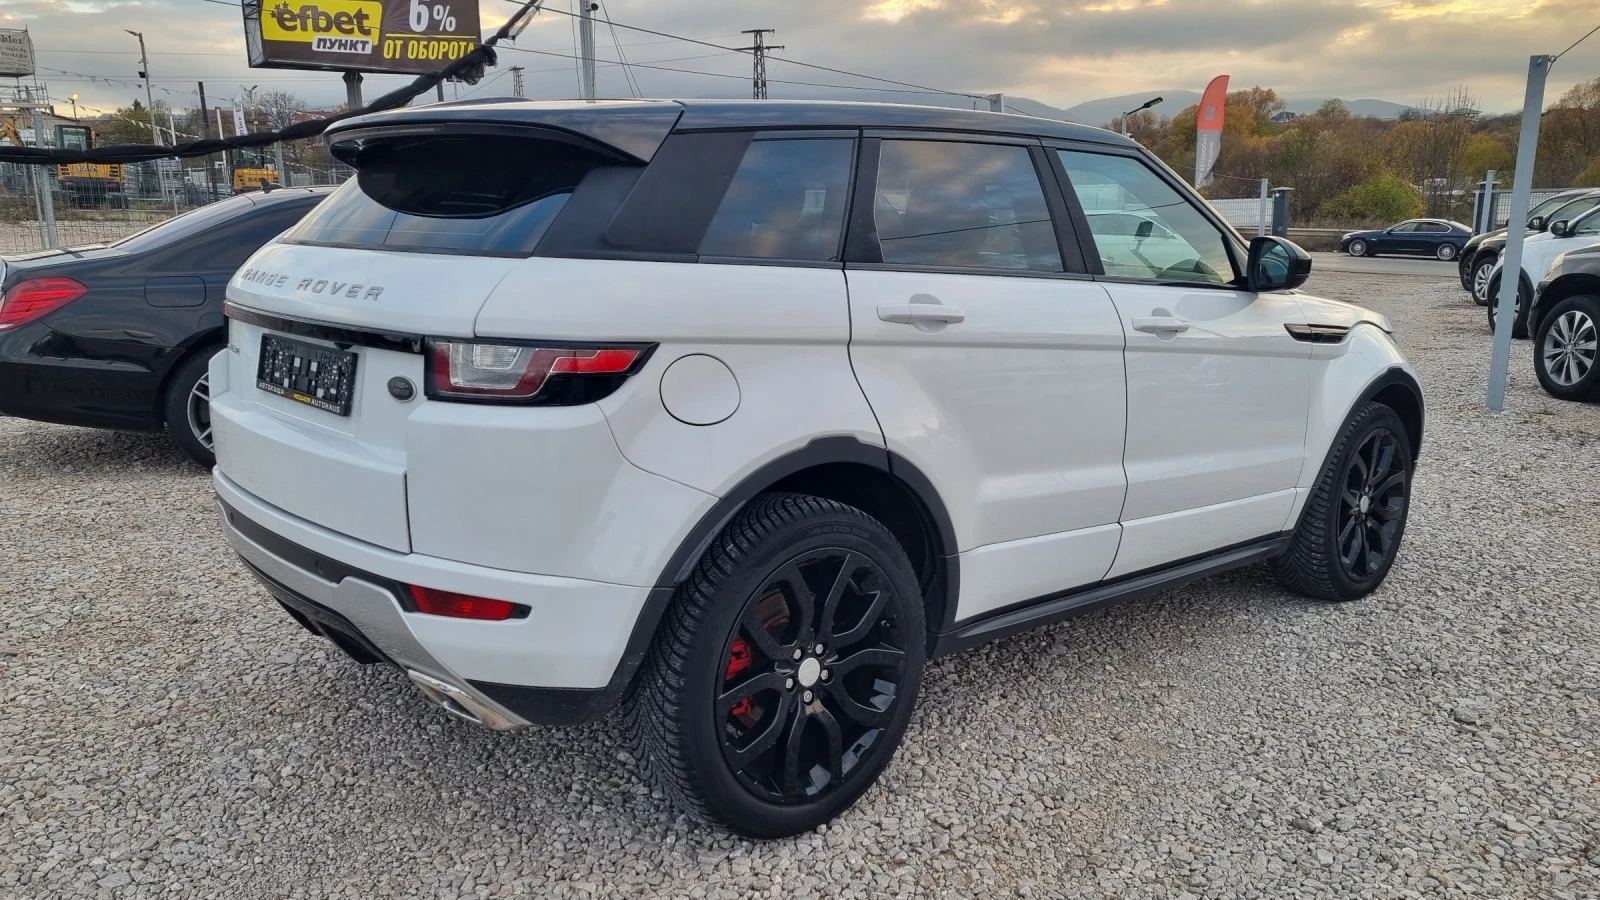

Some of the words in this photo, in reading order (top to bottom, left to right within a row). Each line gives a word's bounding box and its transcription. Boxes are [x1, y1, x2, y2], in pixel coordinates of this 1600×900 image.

[276, 5, 372, 36] efbet
[316, 37, 370, 52] ПУНКТ
[383, 39, 401, 59] ОТ
[407, 40, 475, 60] ОБОРОТА
[241, 268, 289, 287] RANGE
[297, 278, 384, 301] ROVER
[259, 382, 285, 395] АВТОКЪЩА
[311, 399, 340, 413] AUTOHAUS
